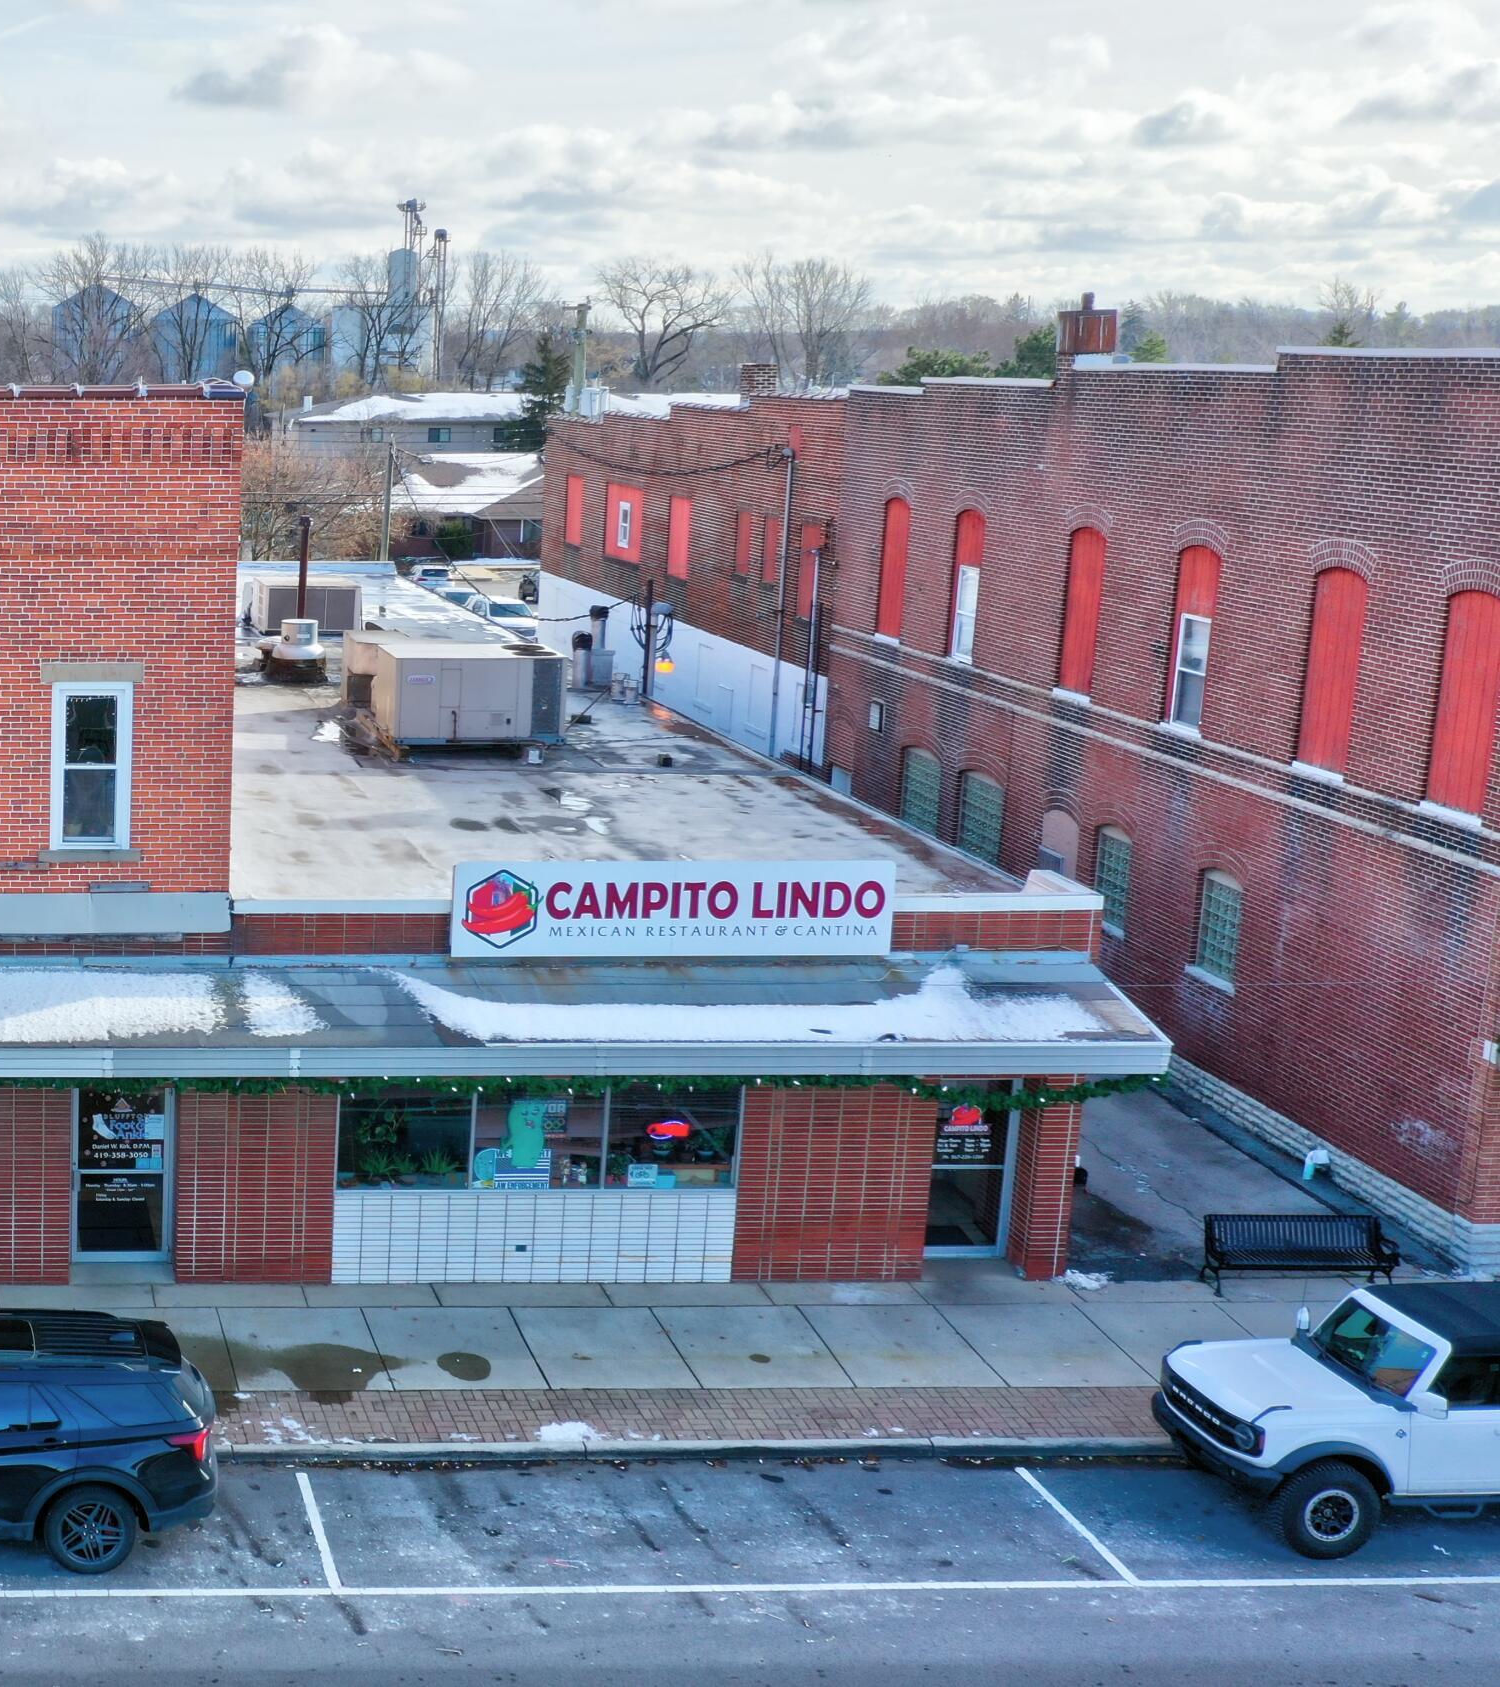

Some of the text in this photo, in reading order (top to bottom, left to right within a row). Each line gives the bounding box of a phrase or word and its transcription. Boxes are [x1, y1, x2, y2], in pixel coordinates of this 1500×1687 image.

[545, 880, 886, 920] CAMPITO LINDO
[548, 925, 878, 937] MEXICAN RESTAURANT & CANTINA
